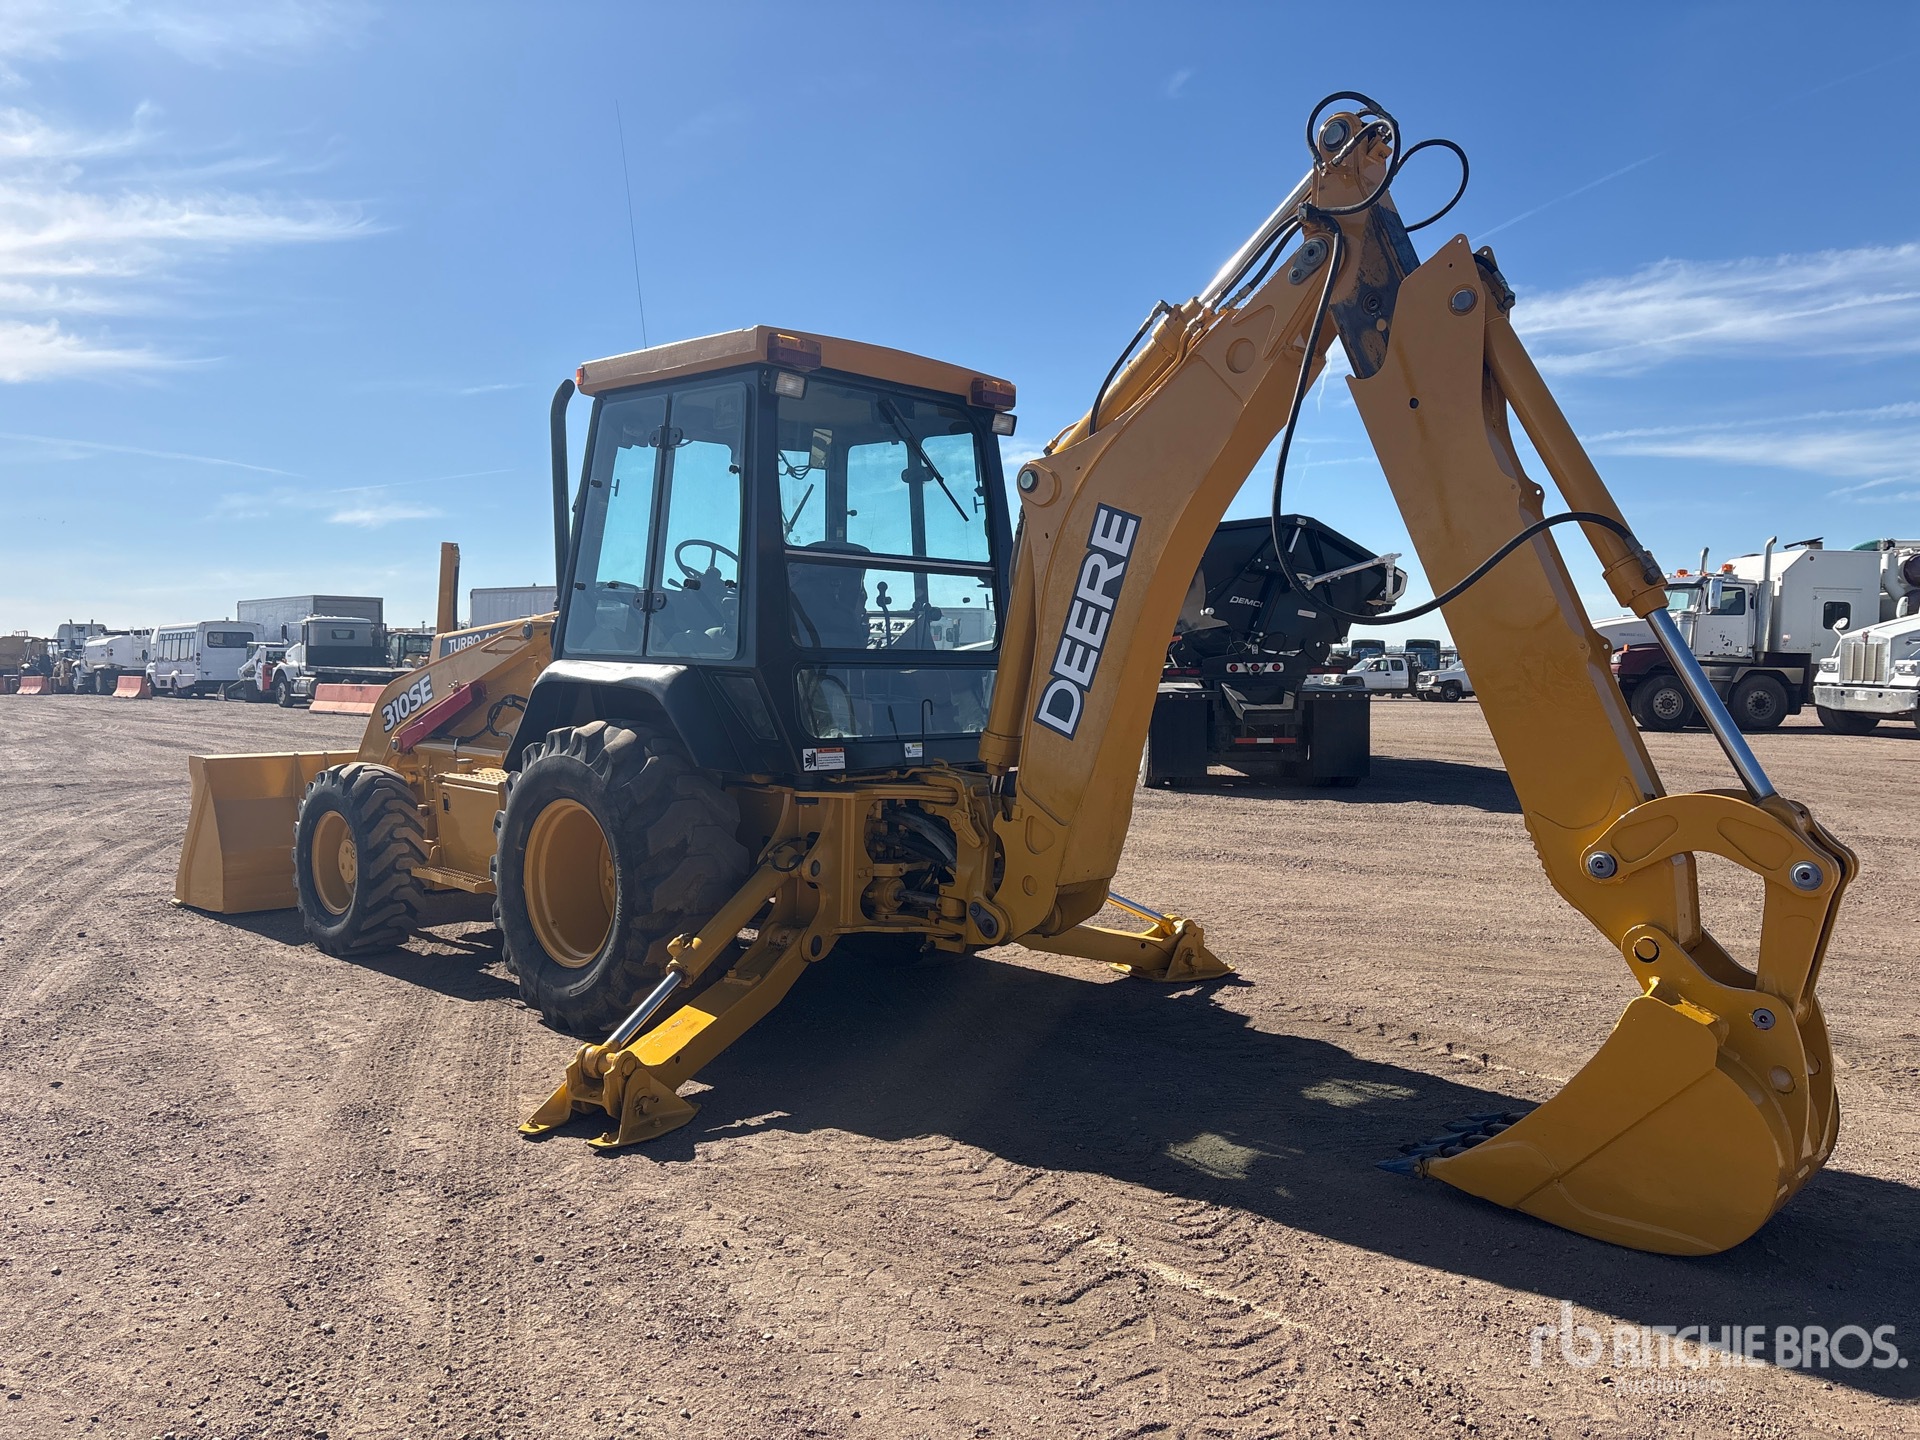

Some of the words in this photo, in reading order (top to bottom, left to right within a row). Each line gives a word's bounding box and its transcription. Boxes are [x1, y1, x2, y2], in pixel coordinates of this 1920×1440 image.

[448, 634, 481, 654] TURBO
[1037, 507, 1137, 735] DEERE
[381, 674, 433, 733] 310SE
